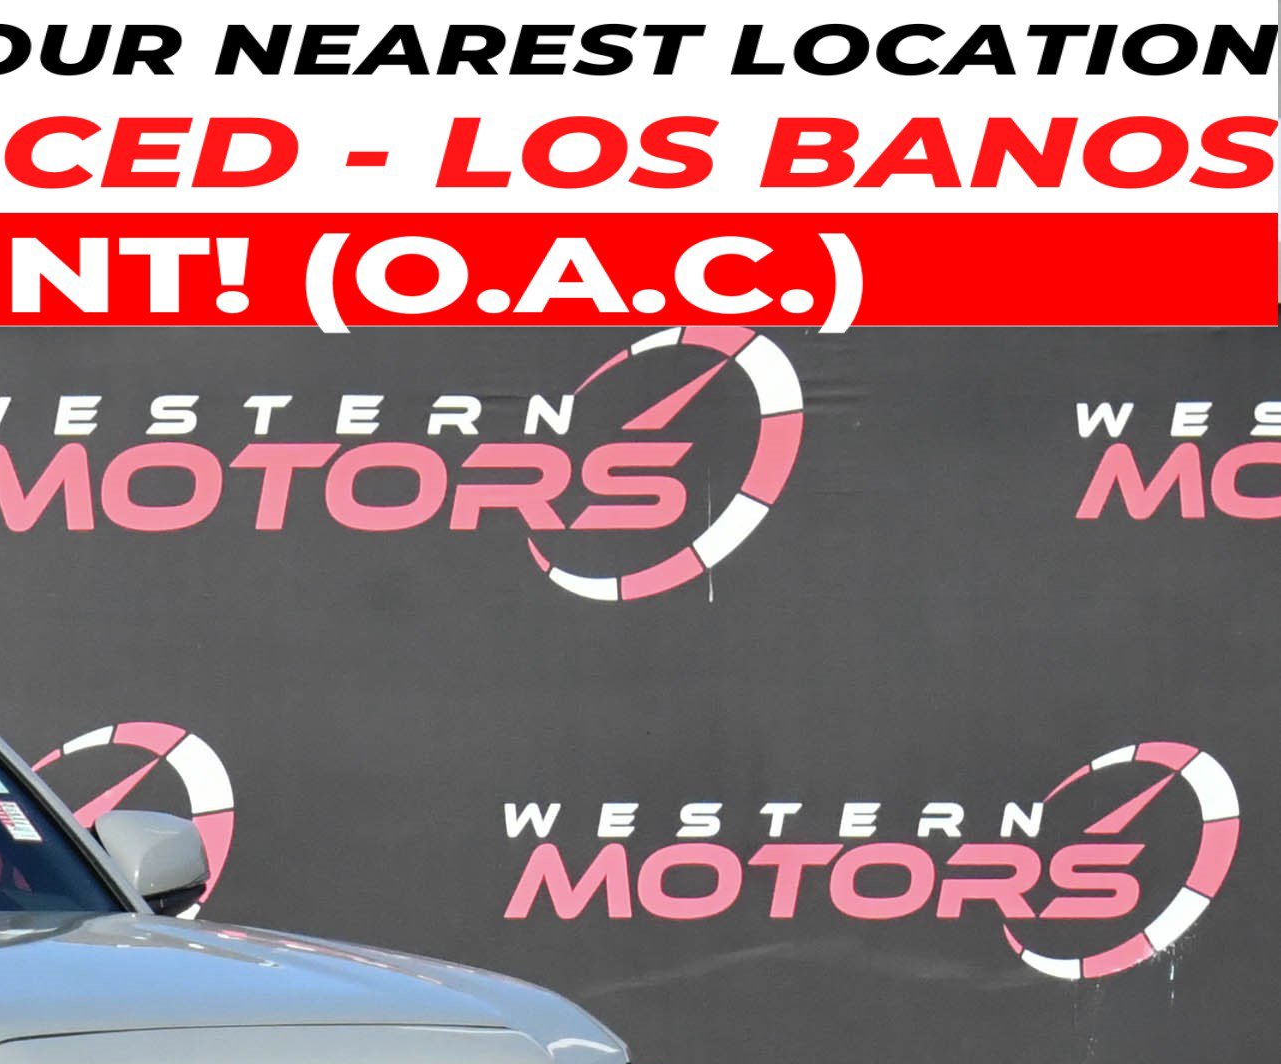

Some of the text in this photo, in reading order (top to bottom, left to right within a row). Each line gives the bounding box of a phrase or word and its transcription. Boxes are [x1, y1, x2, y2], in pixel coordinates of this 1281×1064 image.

[1075, 402, 1281, 438] WES
[503, 802, 1045, 838] WESTERN
[504, 842, 1146, 920] MOTORS
